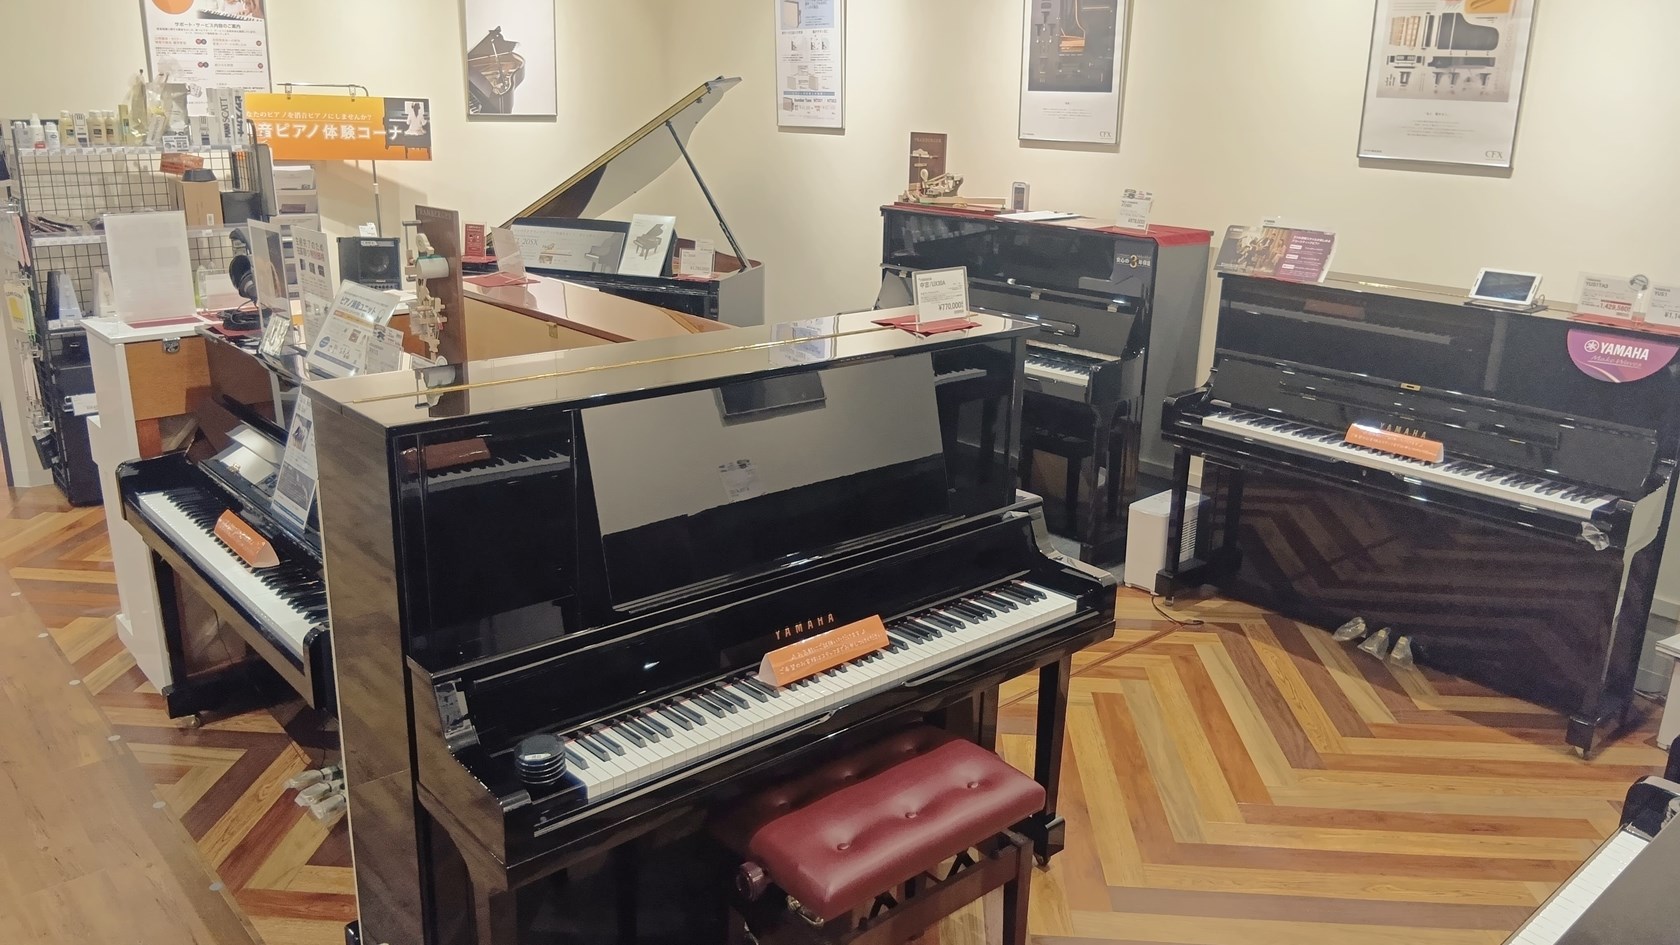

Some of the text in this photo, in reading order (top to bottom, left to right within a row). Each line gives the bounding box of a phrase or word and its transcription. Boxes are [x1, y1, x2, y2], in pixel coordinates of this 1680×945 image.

[246, 110, 373, 121] なたのピアノを消音ピアノにしませんか？
[1485, 150, 1503, 159] CFX
[1600, 342, 1650, 360] YAMAHA
[1380, 422, 1427, 439] YAMAHA
[775, 613, 834, 640] YAMAHA
